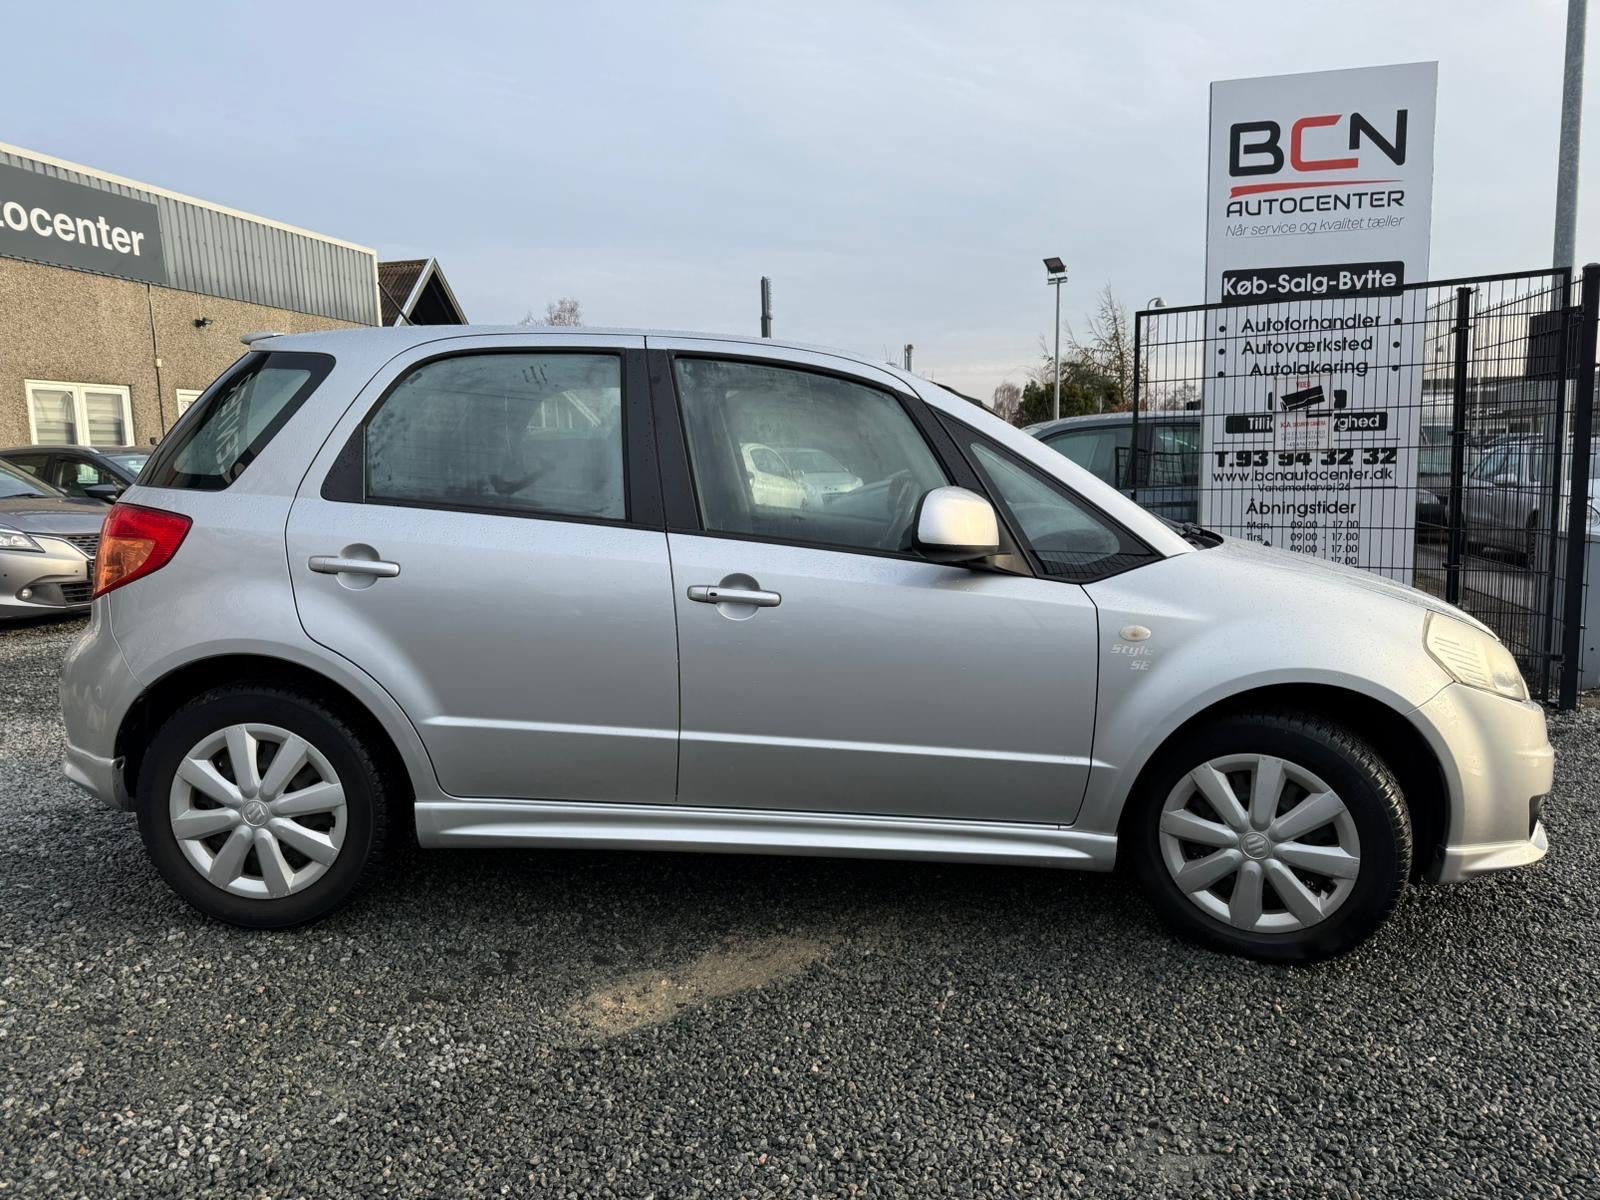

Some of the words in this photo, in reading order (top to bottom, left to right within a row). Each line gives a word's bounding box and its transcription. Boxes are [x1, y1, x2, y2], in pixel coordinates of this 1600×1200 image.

[1229, 109, 1408, 177] BCN
[1226, 190, 1405, 218] AUTOCENTER
[0, 201, 145, 256] ocenter
[1226, 223, 1248, 237] Når
[1250, 222, 1296, 235] service
[1300, 222, 1317, 234] og
[1320, 218, 1364, 231] kvalitet
[1367, 215, 1405, 228] tæller
[1223, 269, 1397, 296] Køb-Salg-Bytte
[1241, 313, 1381, 333] Autoforhandler
[1241, 336, 1374, 355] Autoværksted
[1250, 360, 1369, 377] Autolakering
[1214, 450, 1269, 468] T.93
[1278, 452, 1312, 466] 94
[1320, 448, 1354, 466] 32
[1363, 447, 1397, 465] 32
[1213, 468, 1393, 482] www.bcnautocenter.dk
[1246, 497, 1356, 517] Åbningstider
[1332, 532, 1358, 541] 17.00
[1331, 544, 1358, 552] 17.00
[1111, 643, 1152, 657] Style
[1130, 660, 1152, 671] SE
